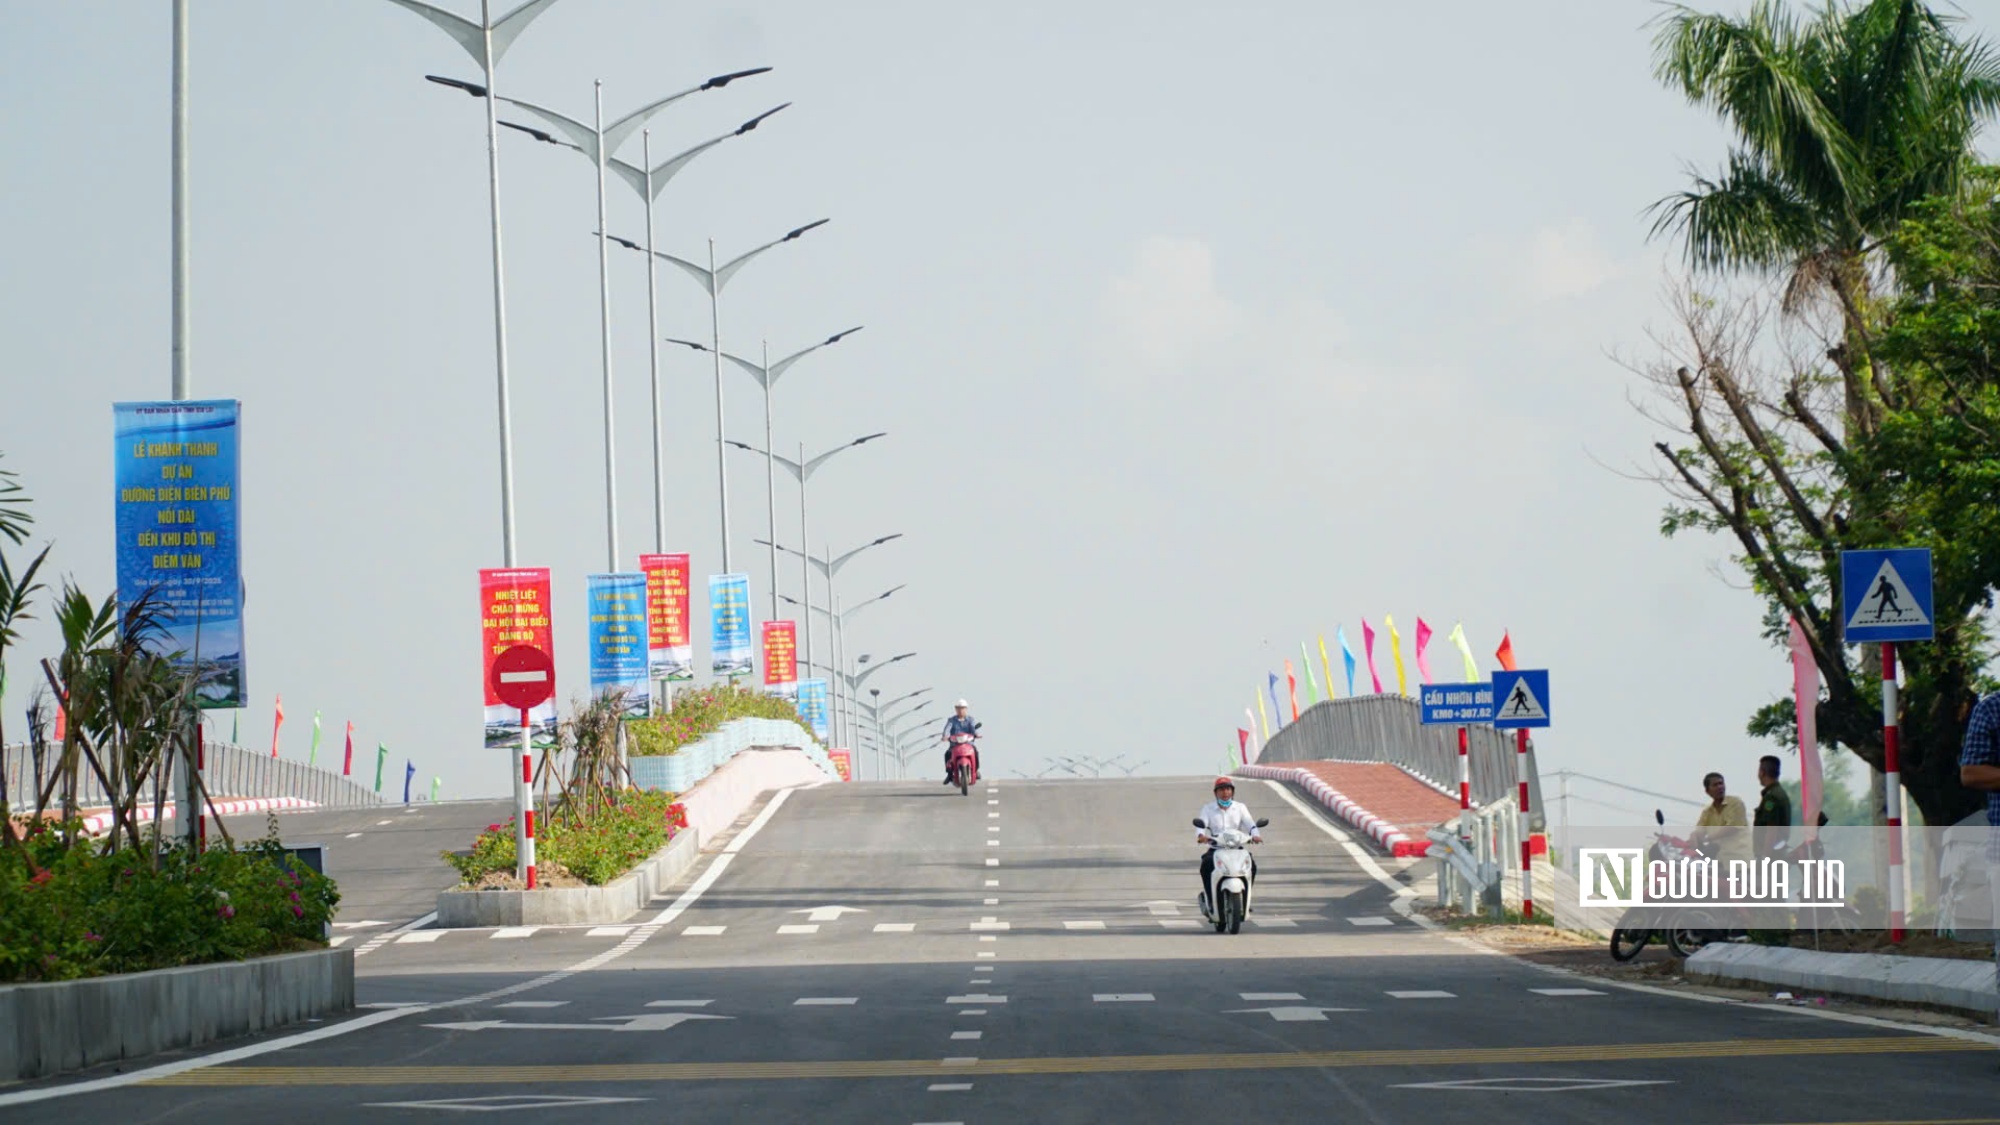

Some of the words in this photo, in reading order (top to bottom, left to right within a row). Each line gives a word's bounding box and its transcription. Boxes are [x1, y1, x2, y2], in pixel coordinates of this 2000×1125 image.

[161, 532, 181, 547] KHU
[1447, 692, 1473, 705] NHƠN
[1475, 689, 1493, 704] BÌN
